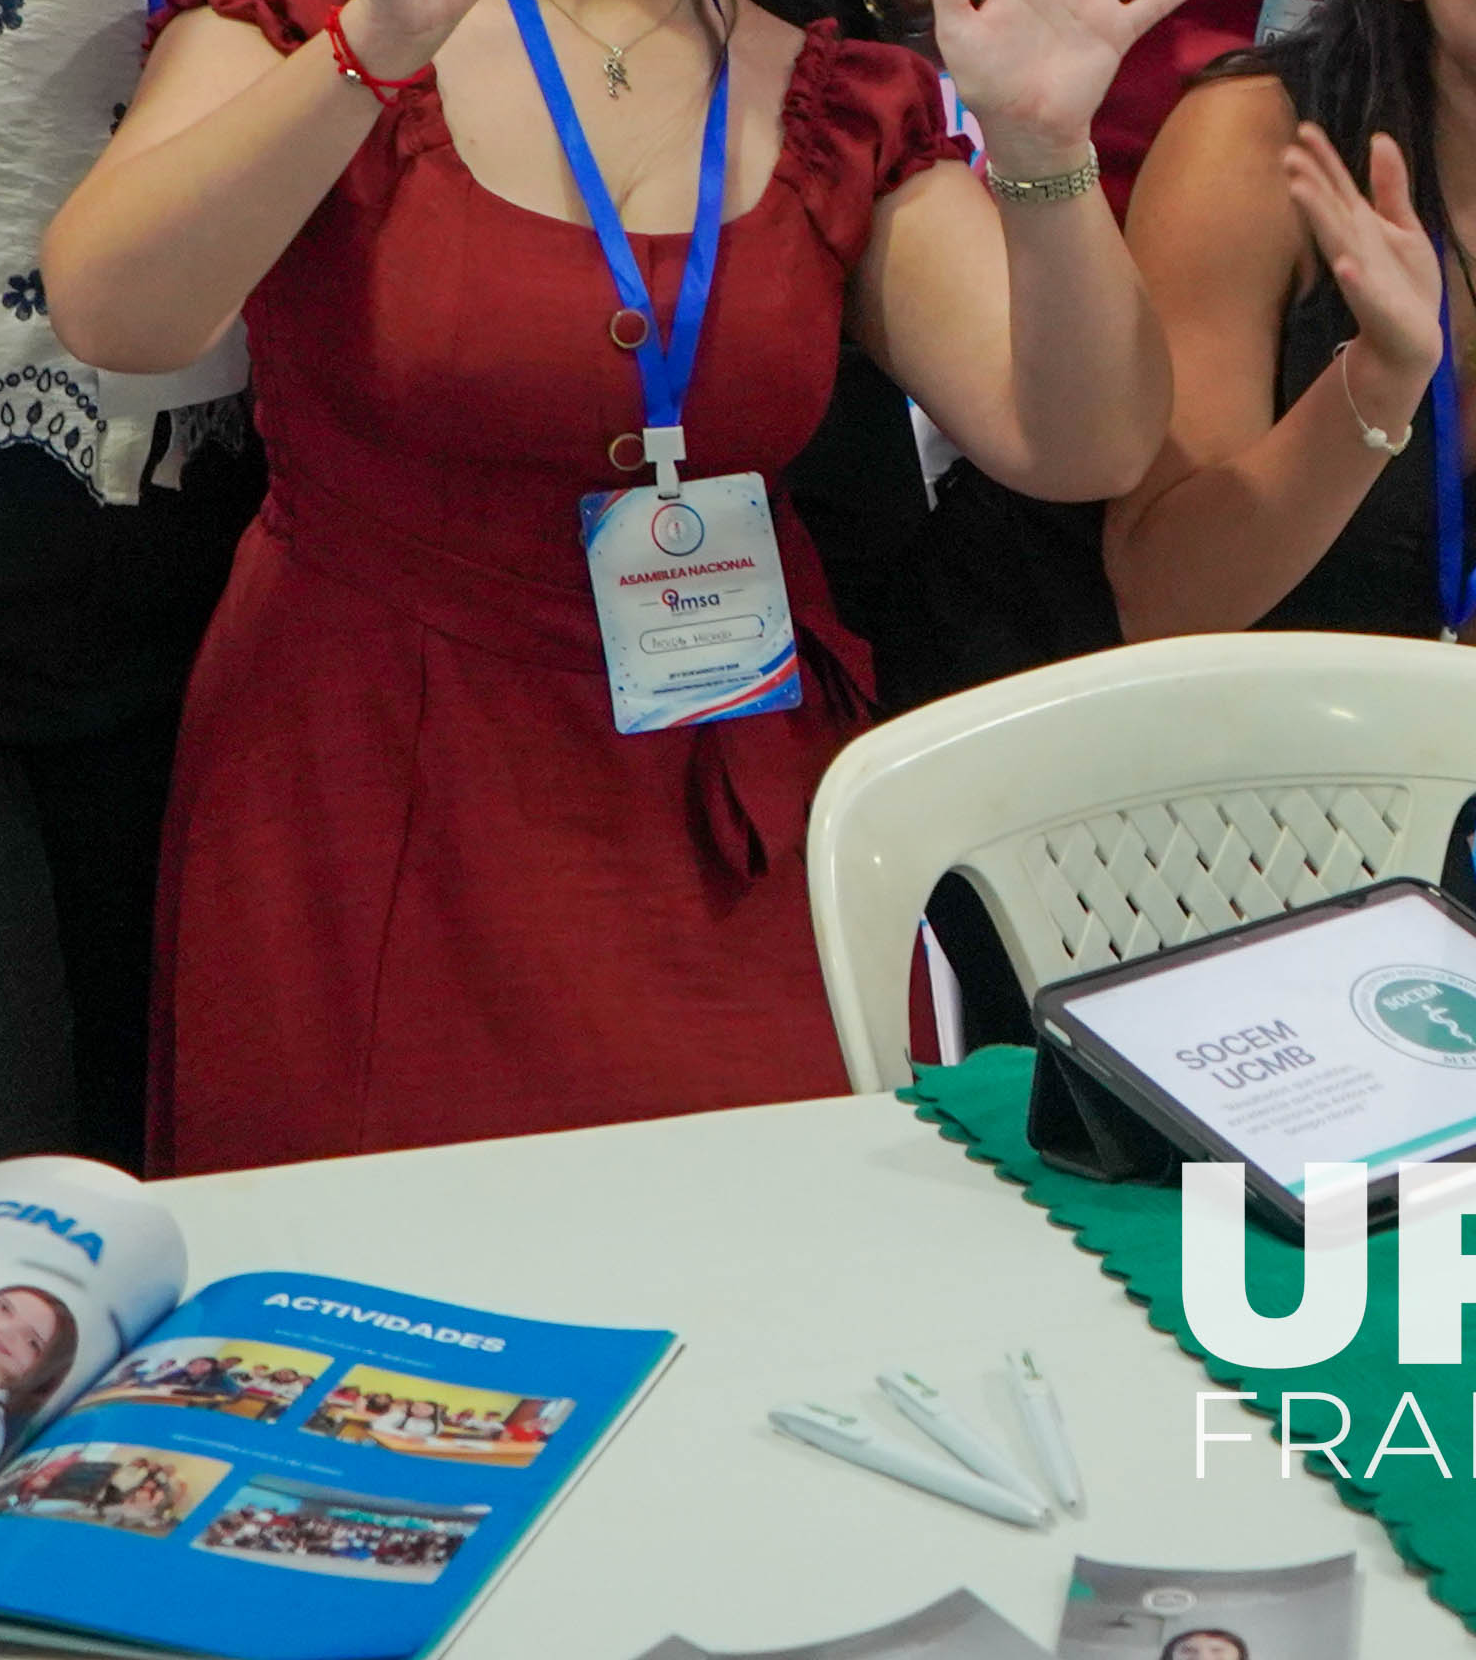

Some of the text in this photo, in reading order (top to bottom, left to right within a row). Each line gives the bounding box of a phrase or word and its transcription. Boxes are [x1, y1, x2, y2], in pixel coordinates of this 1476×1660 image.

[619, 556, 756, 587] ASAMBLEA NACIONAL
[1381, 983, 1444, 1012] SOCEM
[1175, 1019, 1299, 1070] SOCEM
[1211, 1045, 1316, 1090] UCMB
[262, 1292, 507, 1354] ACTIVIDADES
